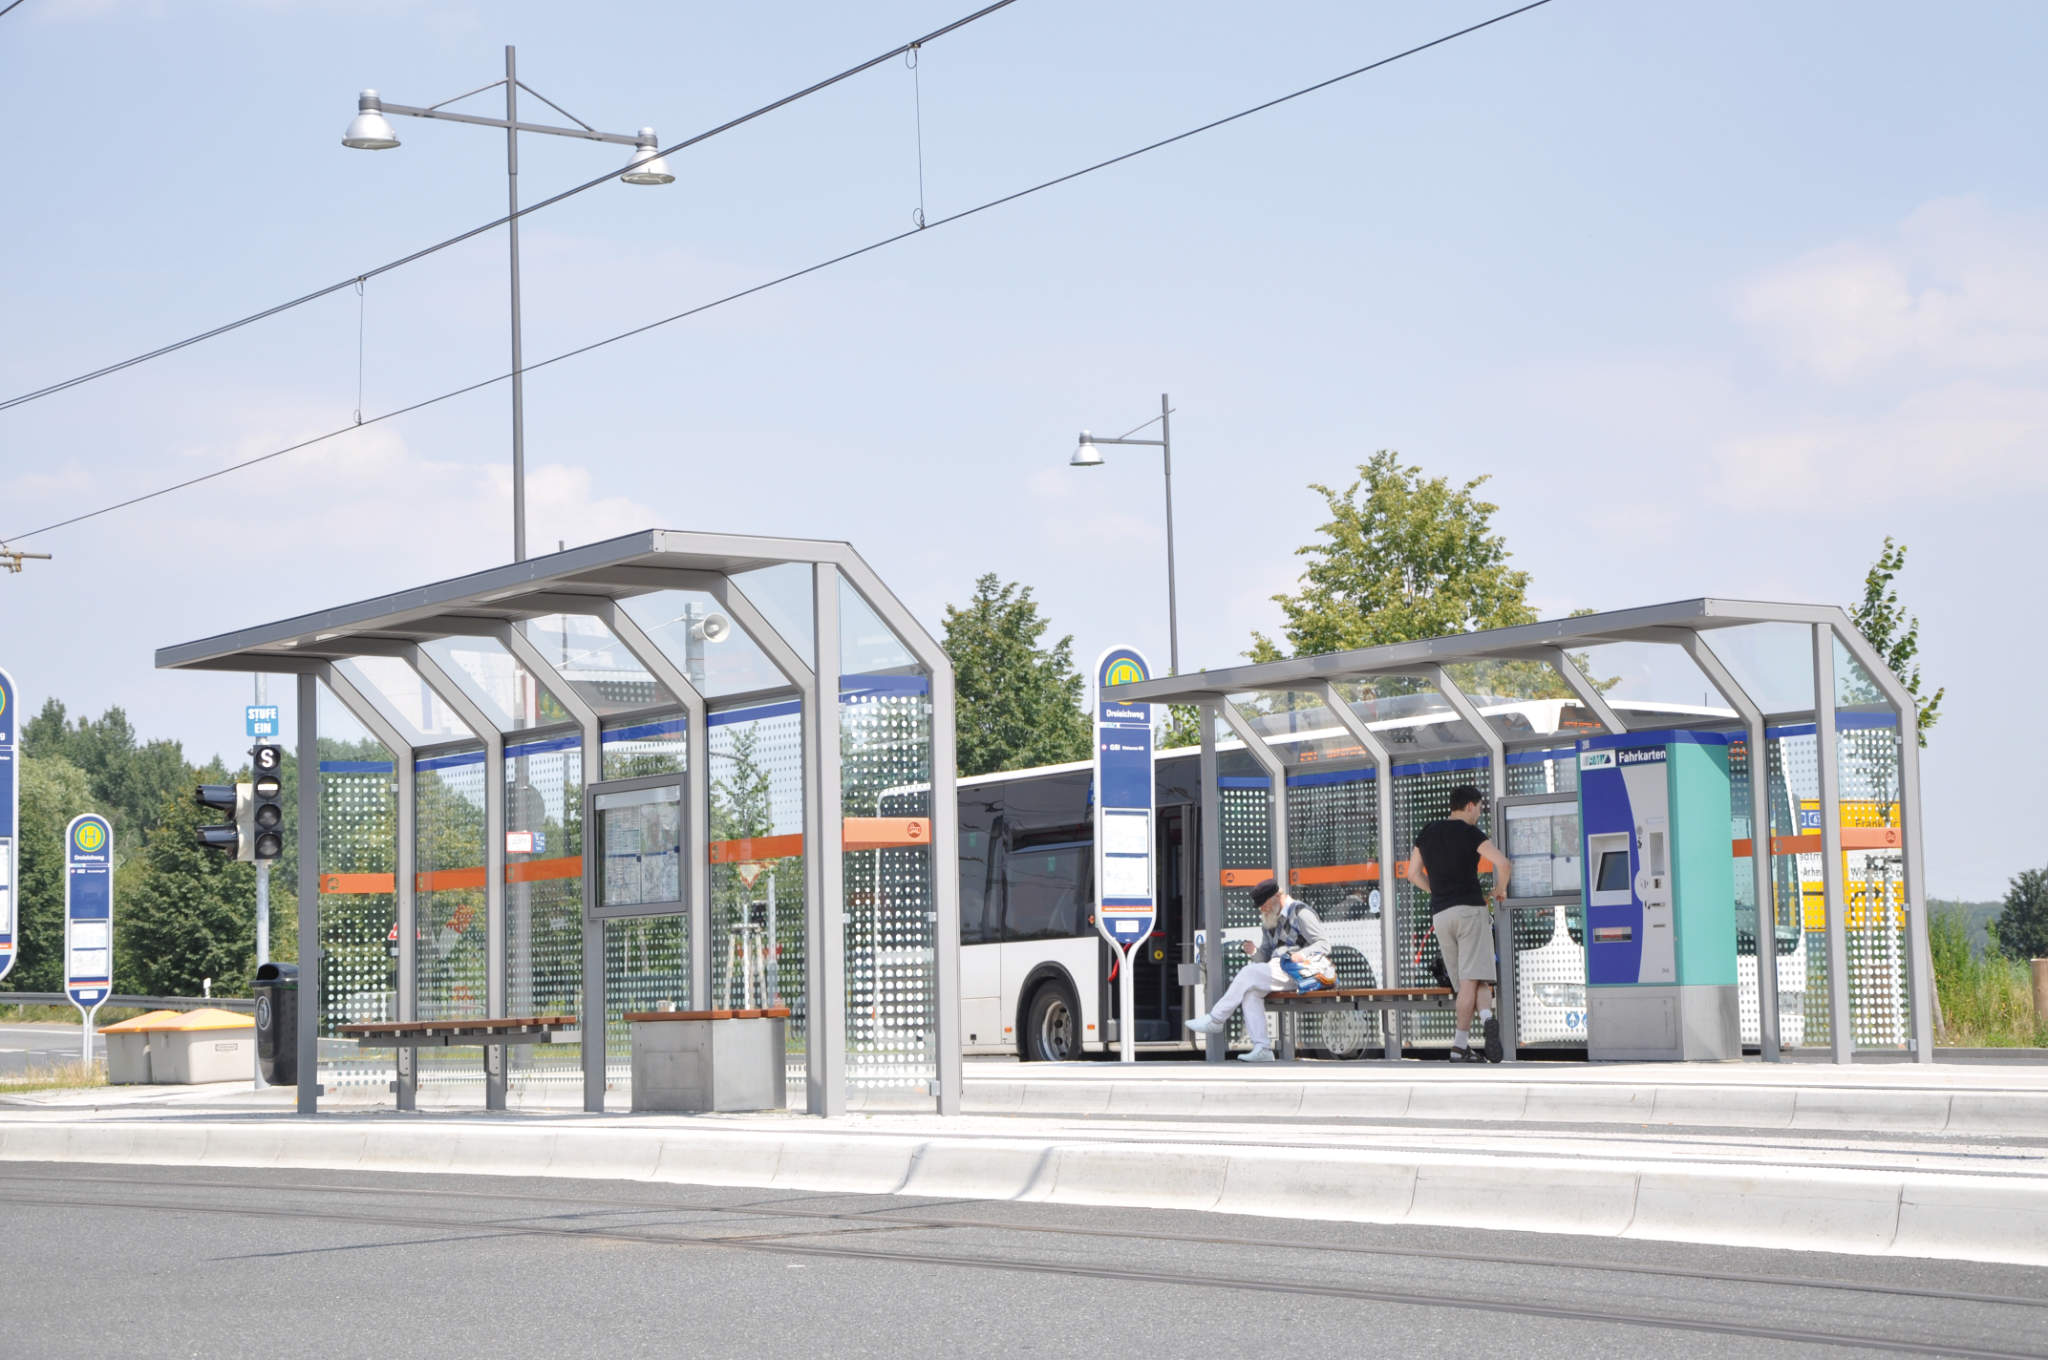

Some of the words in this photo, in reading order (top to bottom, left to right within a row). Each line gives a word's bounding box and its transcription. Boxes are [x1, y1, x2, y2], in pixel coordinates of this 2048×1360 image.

[248, 708, 277, 720] STUFE
[254, 722, 272, 733] EIN
[261, 749, 274, 767] S
[1618, 750, 1667, 763] Fahrkarten
[84, 829, 97, 845] H
